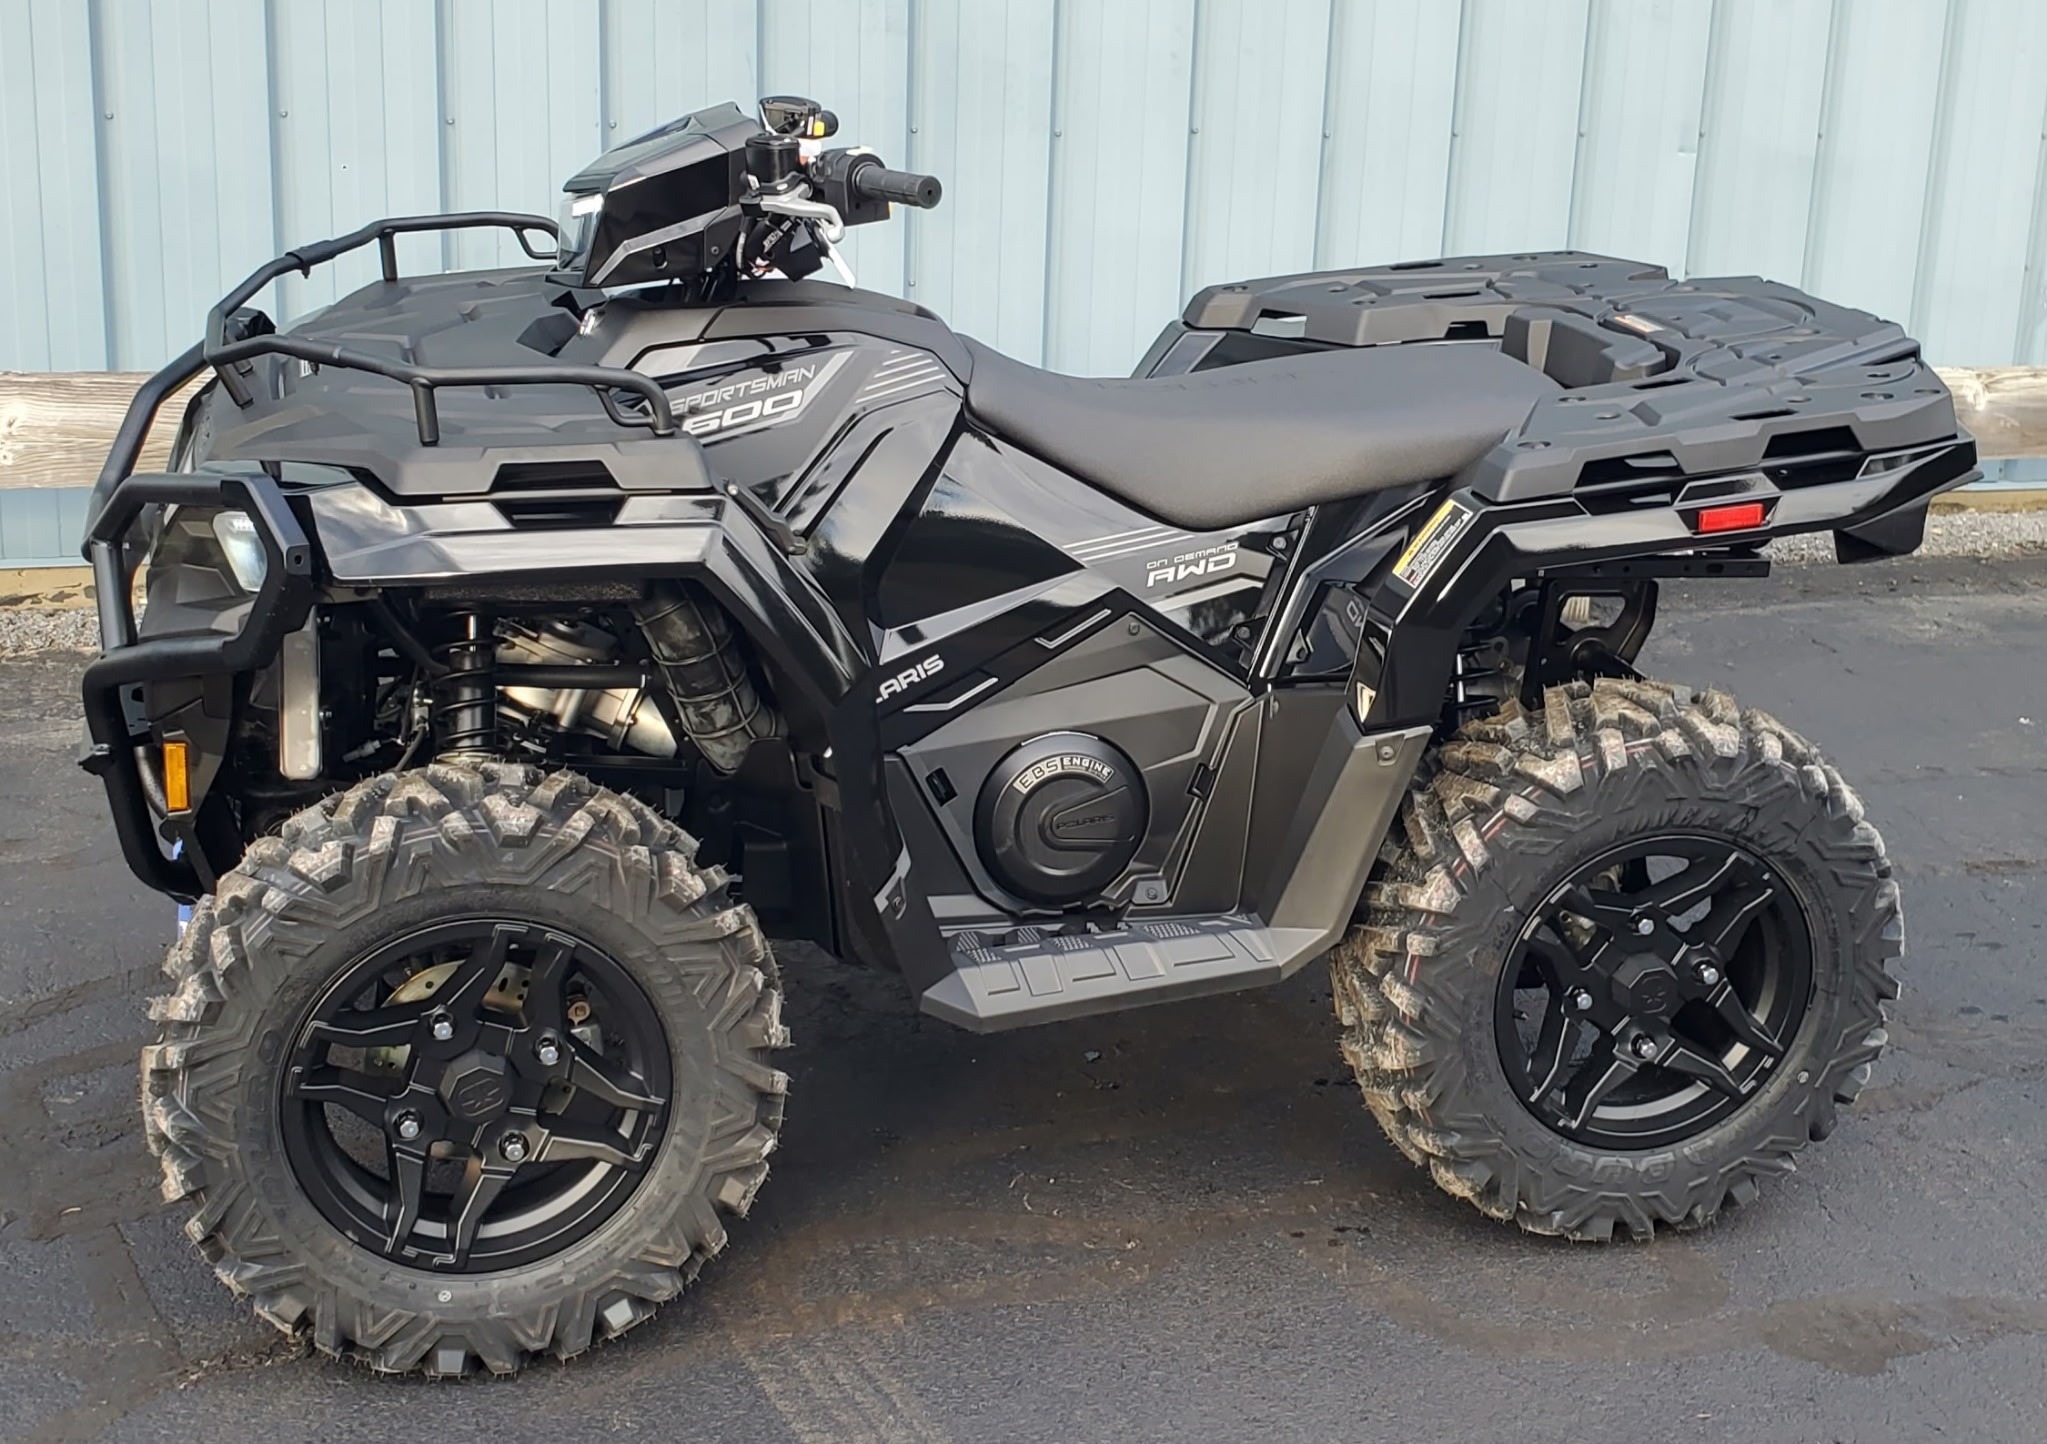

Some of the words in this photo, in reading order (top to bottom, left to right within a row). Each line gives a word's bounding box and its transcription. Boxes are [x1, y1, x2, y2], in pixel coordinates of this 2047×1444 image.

[670, 364, 815, 416] SPORTSMAN
[1146, 558, 1168, 570] ON
[1174, 541, 1239, 563] DEMAND
[1146, 552, 1237, 587] AWD
[876, 654, 945, 704] ARIS
[1018, 759, 1059, 790] EBS
[1062, 756, 1111, 779] ENGINE
